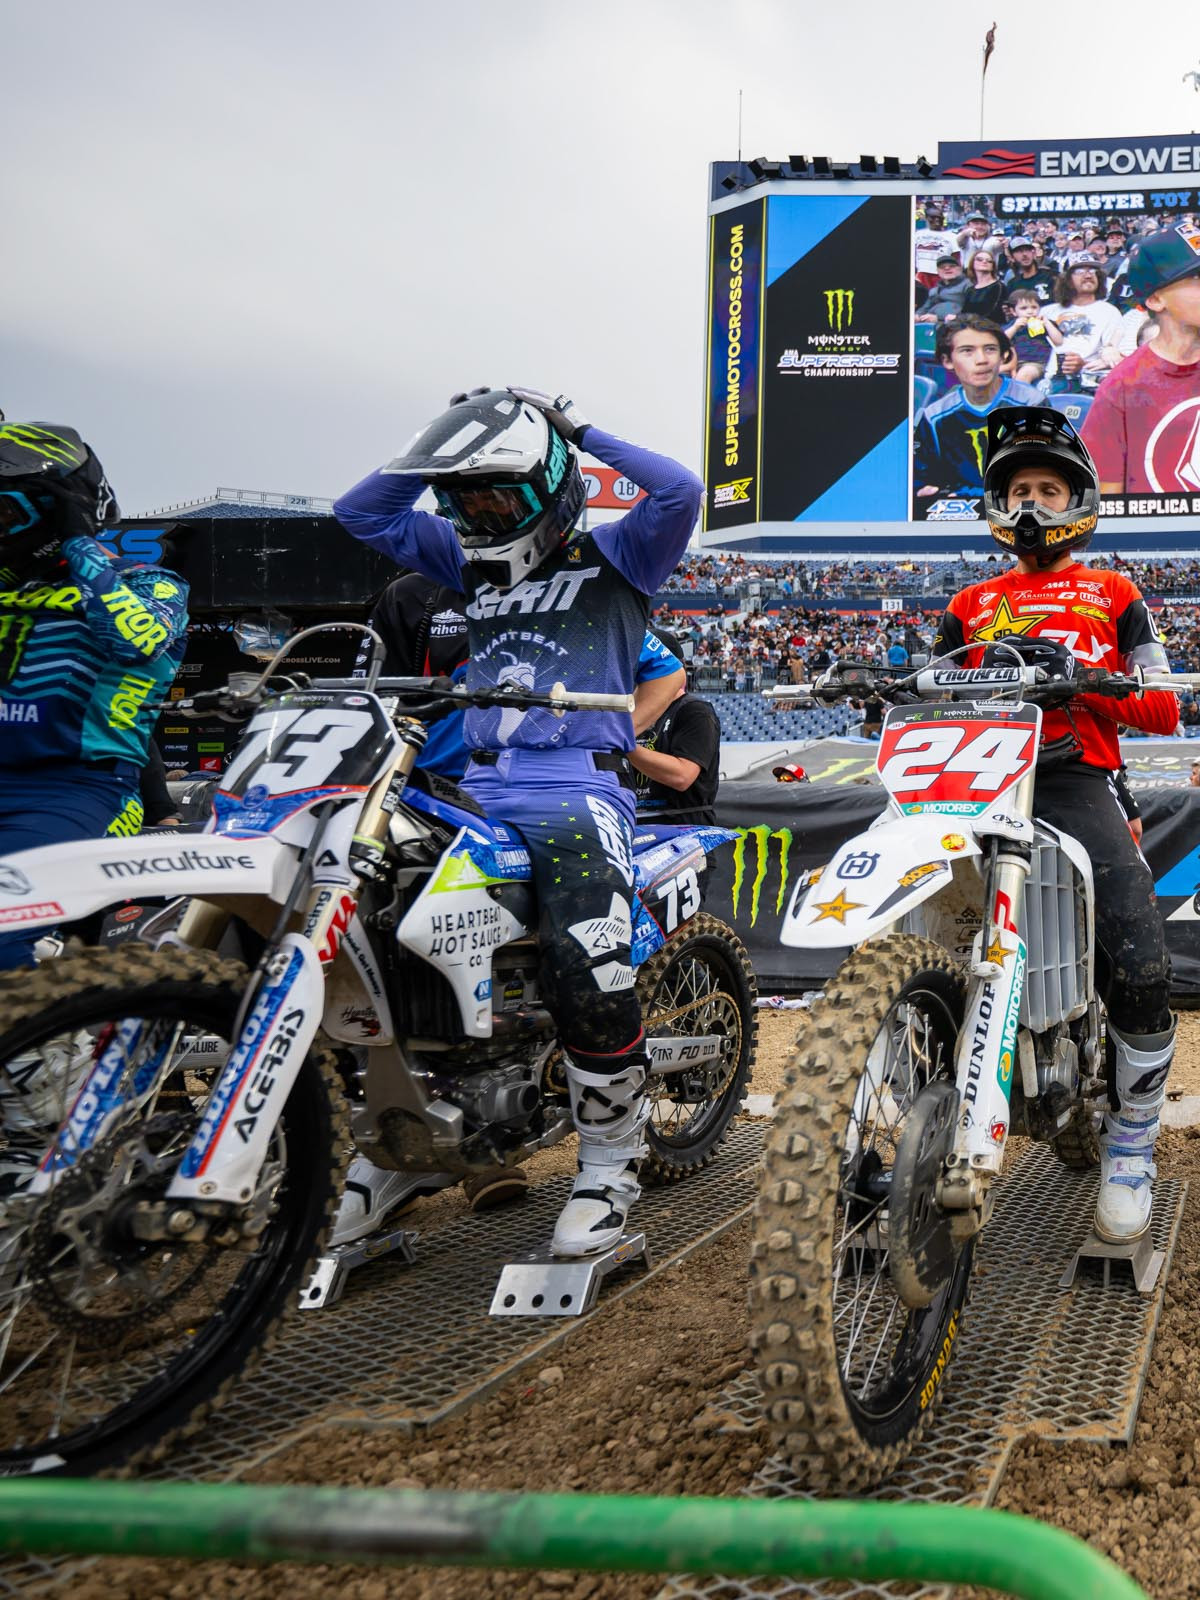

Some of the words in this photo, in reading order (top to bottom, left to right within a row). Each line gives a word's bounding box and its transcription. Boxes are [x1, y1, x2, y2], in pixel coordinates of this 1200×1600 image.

[1001, 193, 1145, 213] SPINMASTER
[1150, 191, 1192, 208] TOY
[725, 224, 744, 467] SUPERMOTOCROSS.COM
[808, 335, 871, 347] MONSTER
[779, 355, 901, 367] SUPERCROSS
[804, 368, 874, 376] CHAMPIONSHIP
[617, 480, 635, 495] 18
[1128, 499, 1190, 515] REPLICA
[1046, 514, 1098, 546] ROCKSTAR
[101, 583, 168, 657] THOR
[884, 600, 901, 610] 131
[473, 632, 568, 662] HEARTBEAT
[881, 726, 1035, 793] 24
[923, 803, 980, 813] MOTOREX
[100, 850, 257, 880] mxculture
[303, 891, 331, 938] acing
[656, 867, 701, 933] 73
[429, 933, 468, 957] HOT
[471, 927, 501, 949] SAUCE
[468, 954, 484, 968] CO.
[1002, 951, 1027, 1051] MOTOREX
[963, 981, 997, 1105] DUNLOP
